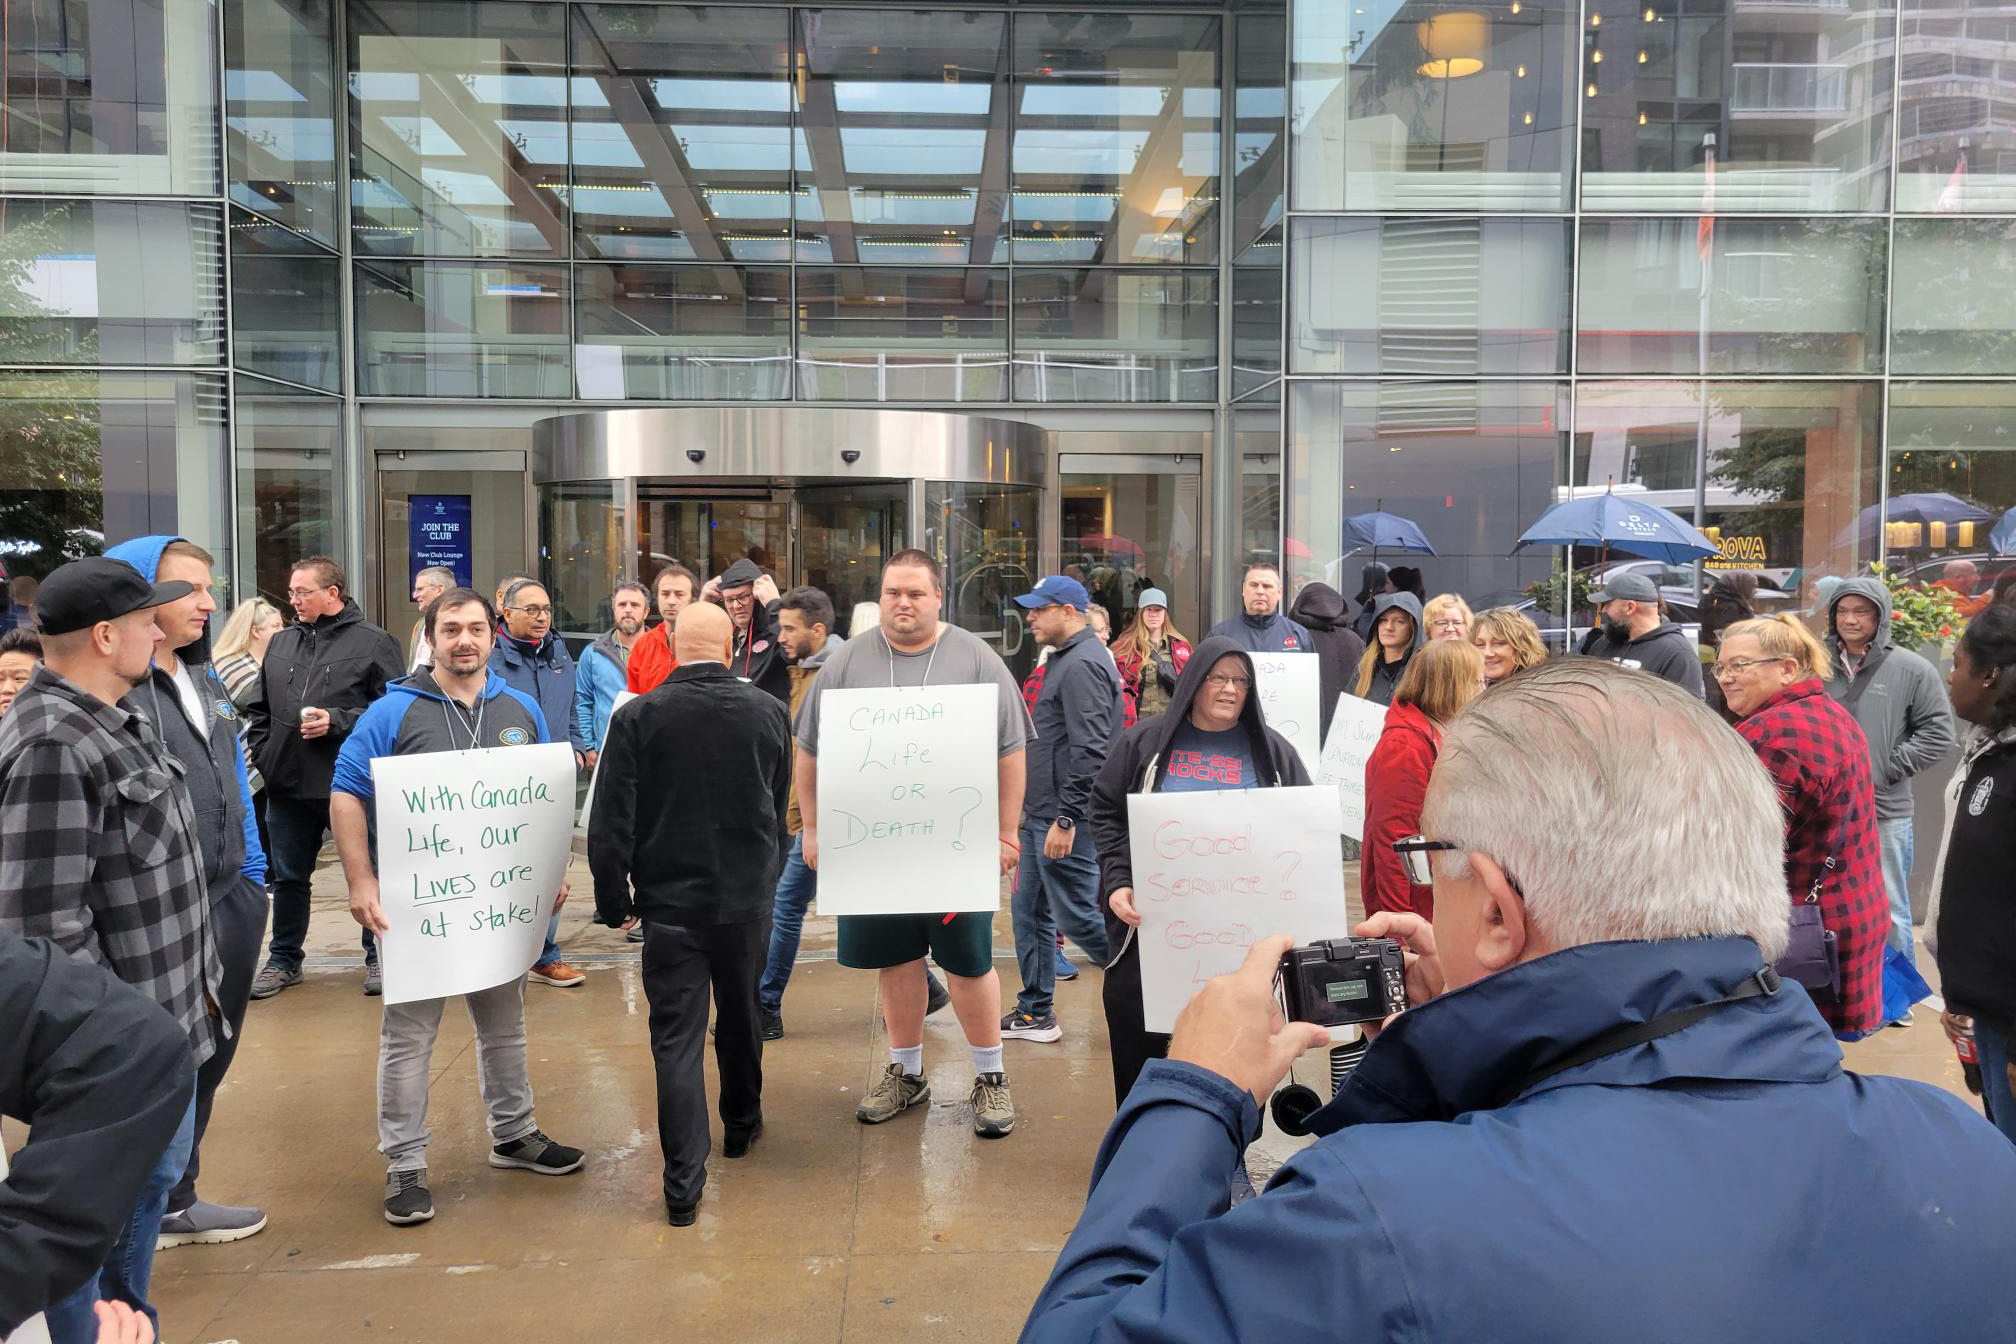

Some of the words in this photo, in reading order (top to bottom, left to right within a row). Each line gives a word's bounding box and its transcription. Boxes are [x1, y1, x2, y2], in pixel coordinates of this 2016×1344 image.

[421, 523, 441, 532] JOIN
[442, 523, 460, 532] THE
[429, 532, 452, 540] CLUB
[1618, 520, 1660, 529] DELTA
[849, 702, 945, 731] CANADA
[402, 785, 465, 814] With
[471, 775, 555, 810] Canada
[890, 783, 927, 801] OR
[407, 823, 464, 858] Life,
[831, 809, 936, 850] DEATH
[490, 864, 533, 888] are
[420, 911, 447, 938] at
